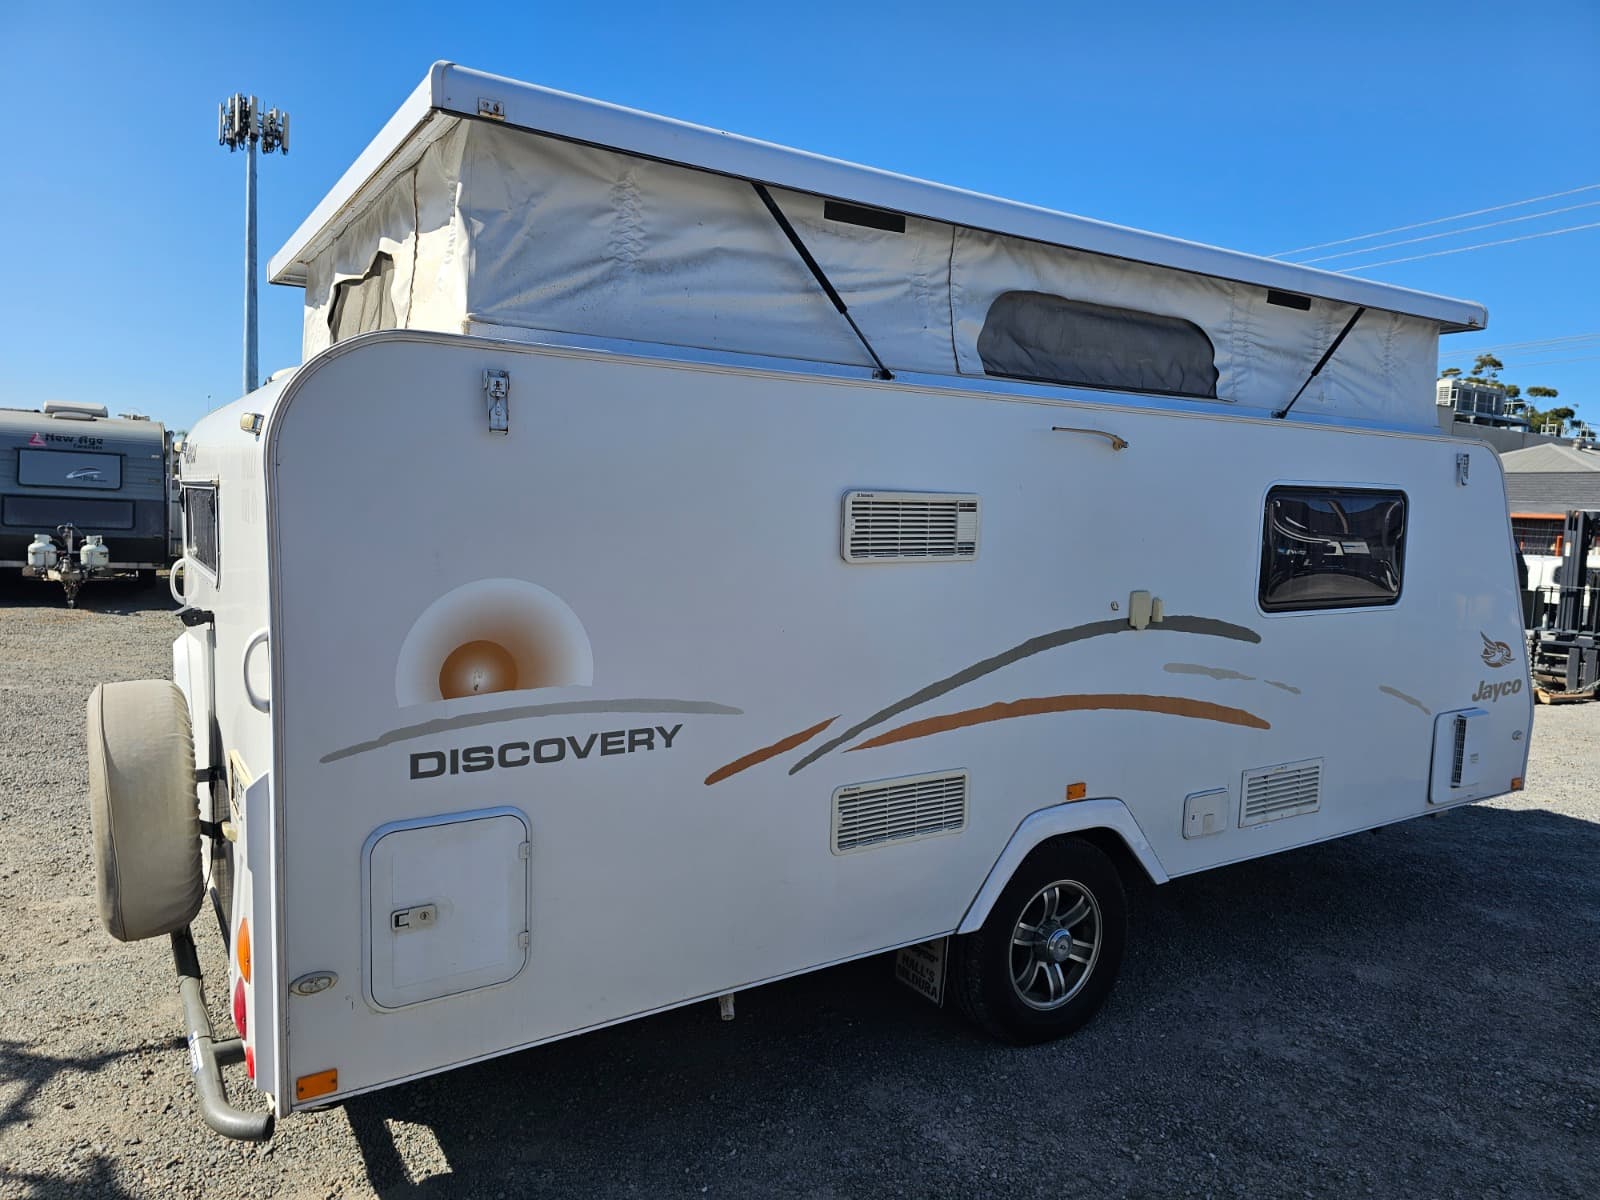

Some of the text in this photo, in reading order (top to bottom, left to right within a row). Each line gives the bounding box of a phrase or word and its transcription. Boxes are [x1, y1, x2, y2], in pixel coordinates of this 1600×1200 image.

[45, 432, 104, 446] New Age
[1472, 678, 1523, 703] Jayco
[409, 724, 684, 780] DISCOVERY
